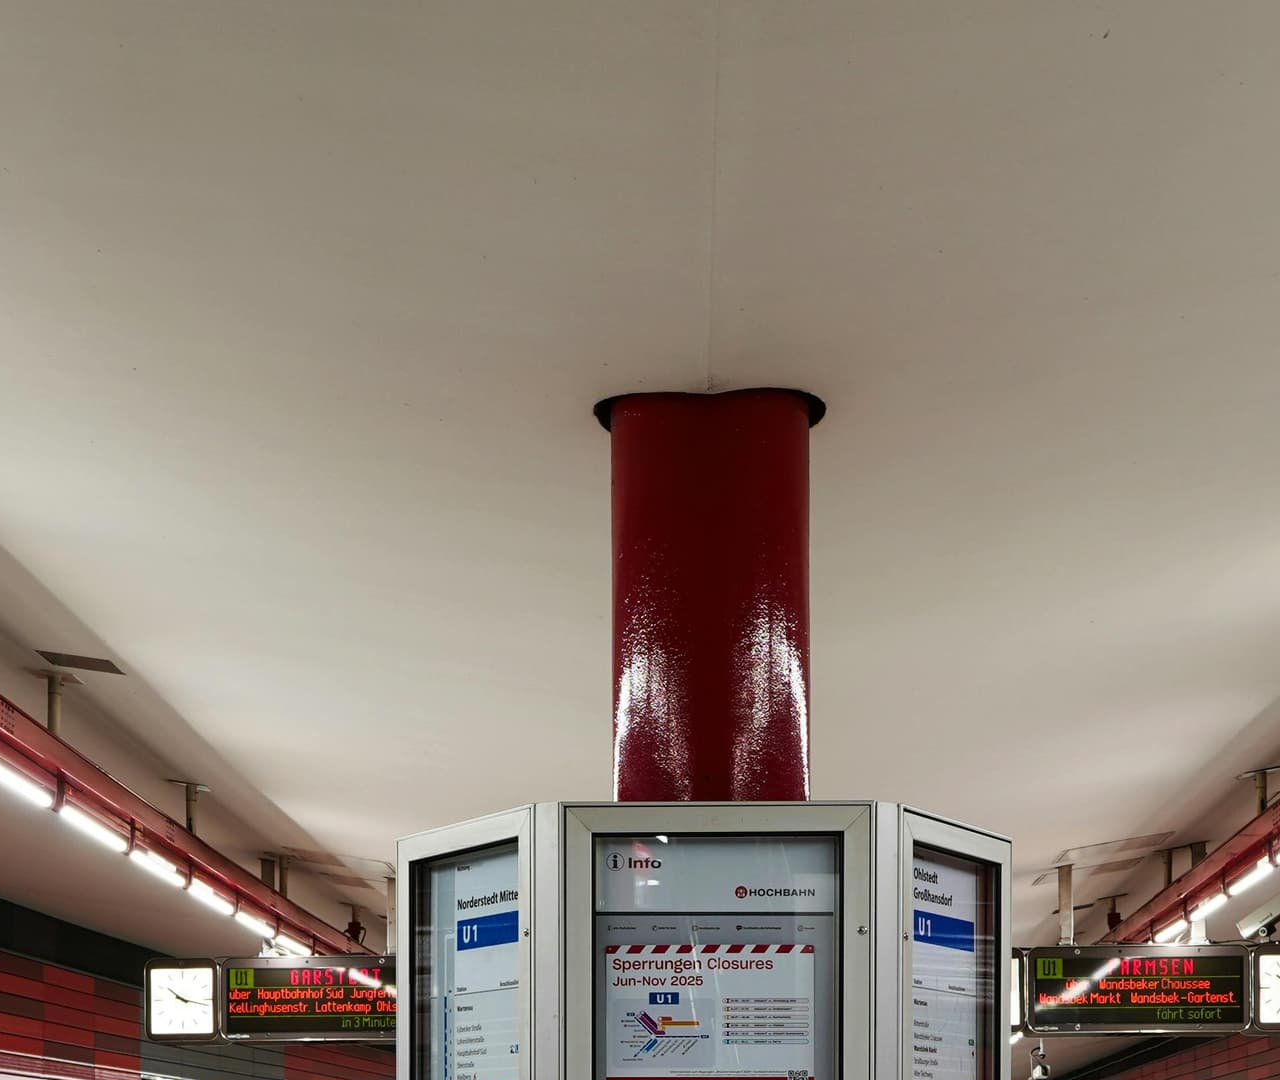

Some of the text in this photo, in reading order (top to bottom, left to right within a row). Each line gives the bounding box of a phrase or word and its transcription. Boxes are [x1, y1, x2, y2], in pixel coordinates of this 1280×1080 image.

[628, 856, 662, 869] Info
[913, 867, 938, 884] Ohlstedt
[749, 887, 816, 897] HOCHBAHN
[913, 887, 952, 906] Großhansdorf
[457, 889, 519, 911] Norderstedt Mitte
[462, 924, 478, 944] U1
[918, 917, 931, 937] U1
[612, 958, 774, 973] Sperrungen Closures
[1042, 958, 1194, 976] U1 ARMSEN
[235, 970, 248, 985] U1
[612, 976, 704, 987] Jun-Nov 2025
[1098, 978, 1159, 991] Wandsbeker
[1161, 978, 1211, 990] Chaussee
[257, 988, 324, 1002] Hauptbahnhof
[656, 994, 672, 1004] U1
[1090, 992, 1121, 1004] Markt
[229, 1001, 311, 1016] Kellinghusenstr.
[315, 1001, 372, 1014] Lattenkamp
[1157, 1008, 1222, 1020] fährt sofort
[341, 1017, 351, 1028] in
[354, 1017, 360, 1028] 3
